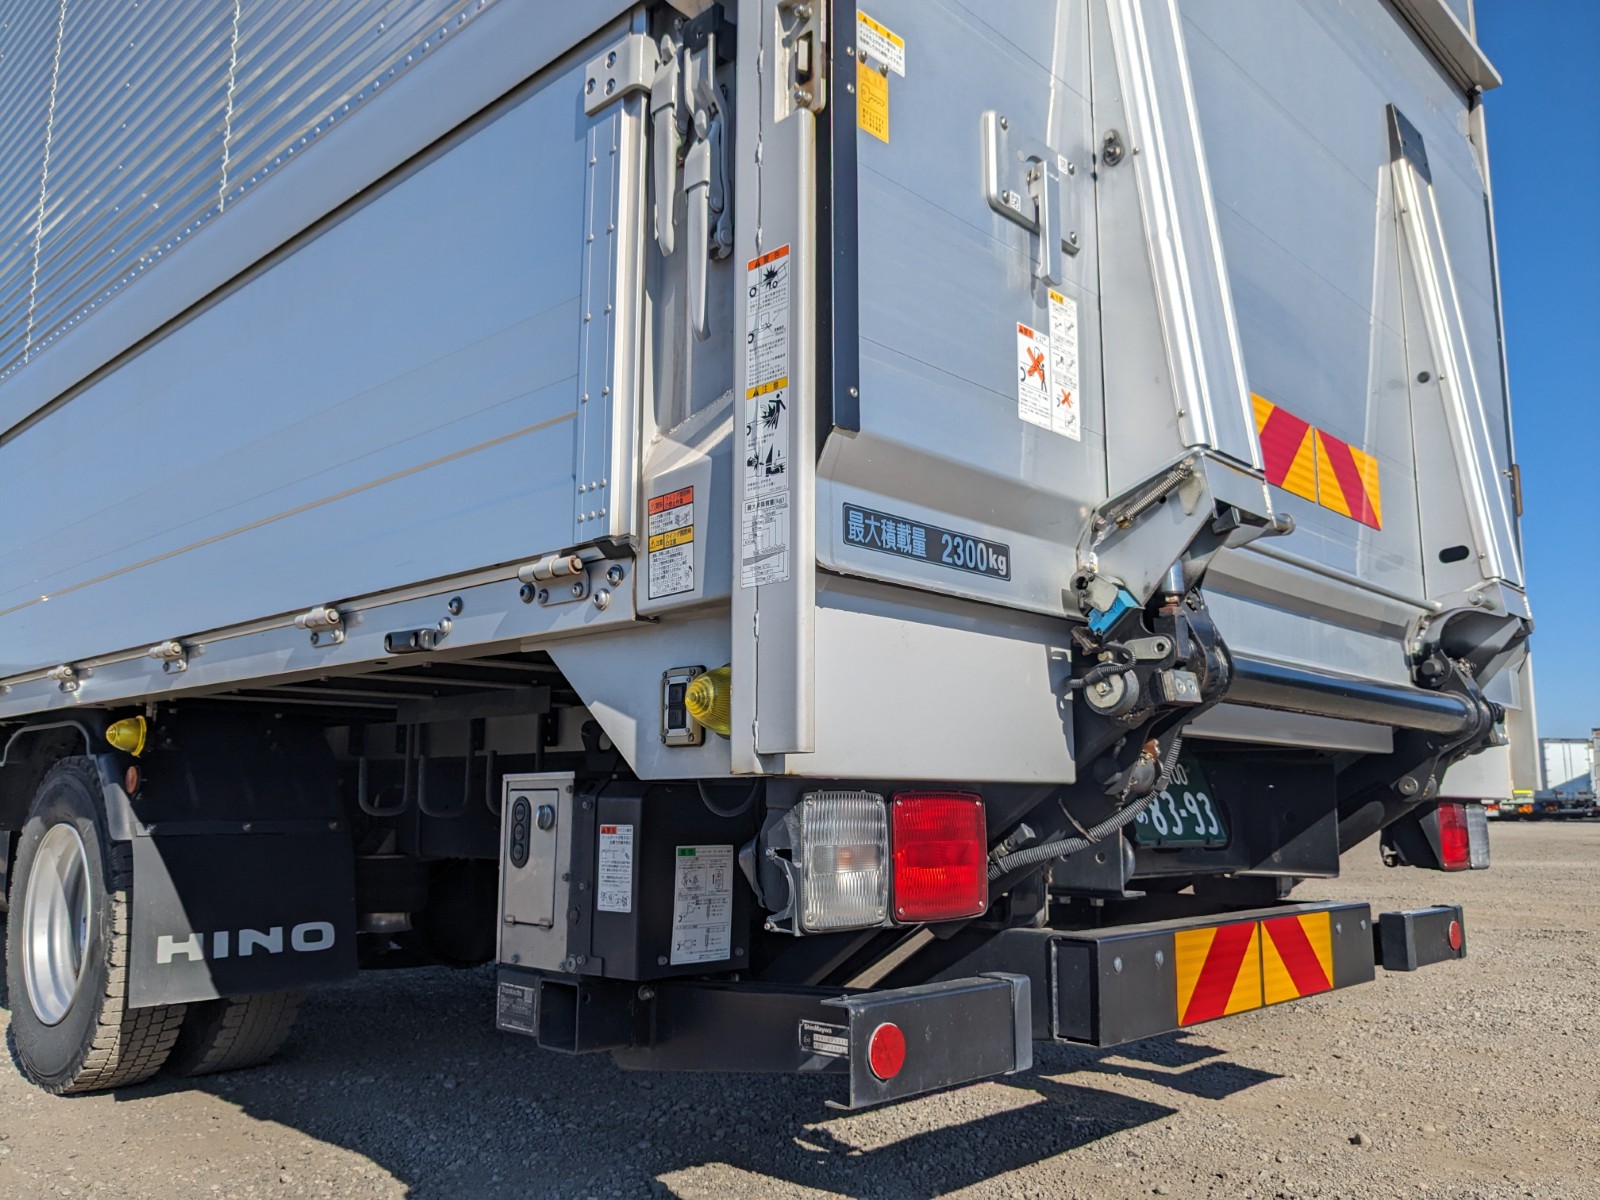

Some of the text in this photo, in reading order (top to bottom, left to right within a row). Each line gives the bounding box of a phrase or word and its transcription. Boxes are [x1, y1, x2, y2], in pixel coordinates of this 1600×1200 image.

[847, 509, 1007, 576] 最大積載量 2300kg
[1168, 763, 1188, 786] 00
[157, 921, 336, 964] HINO
[803, 1023, 833, 1035] ShinMaywa
